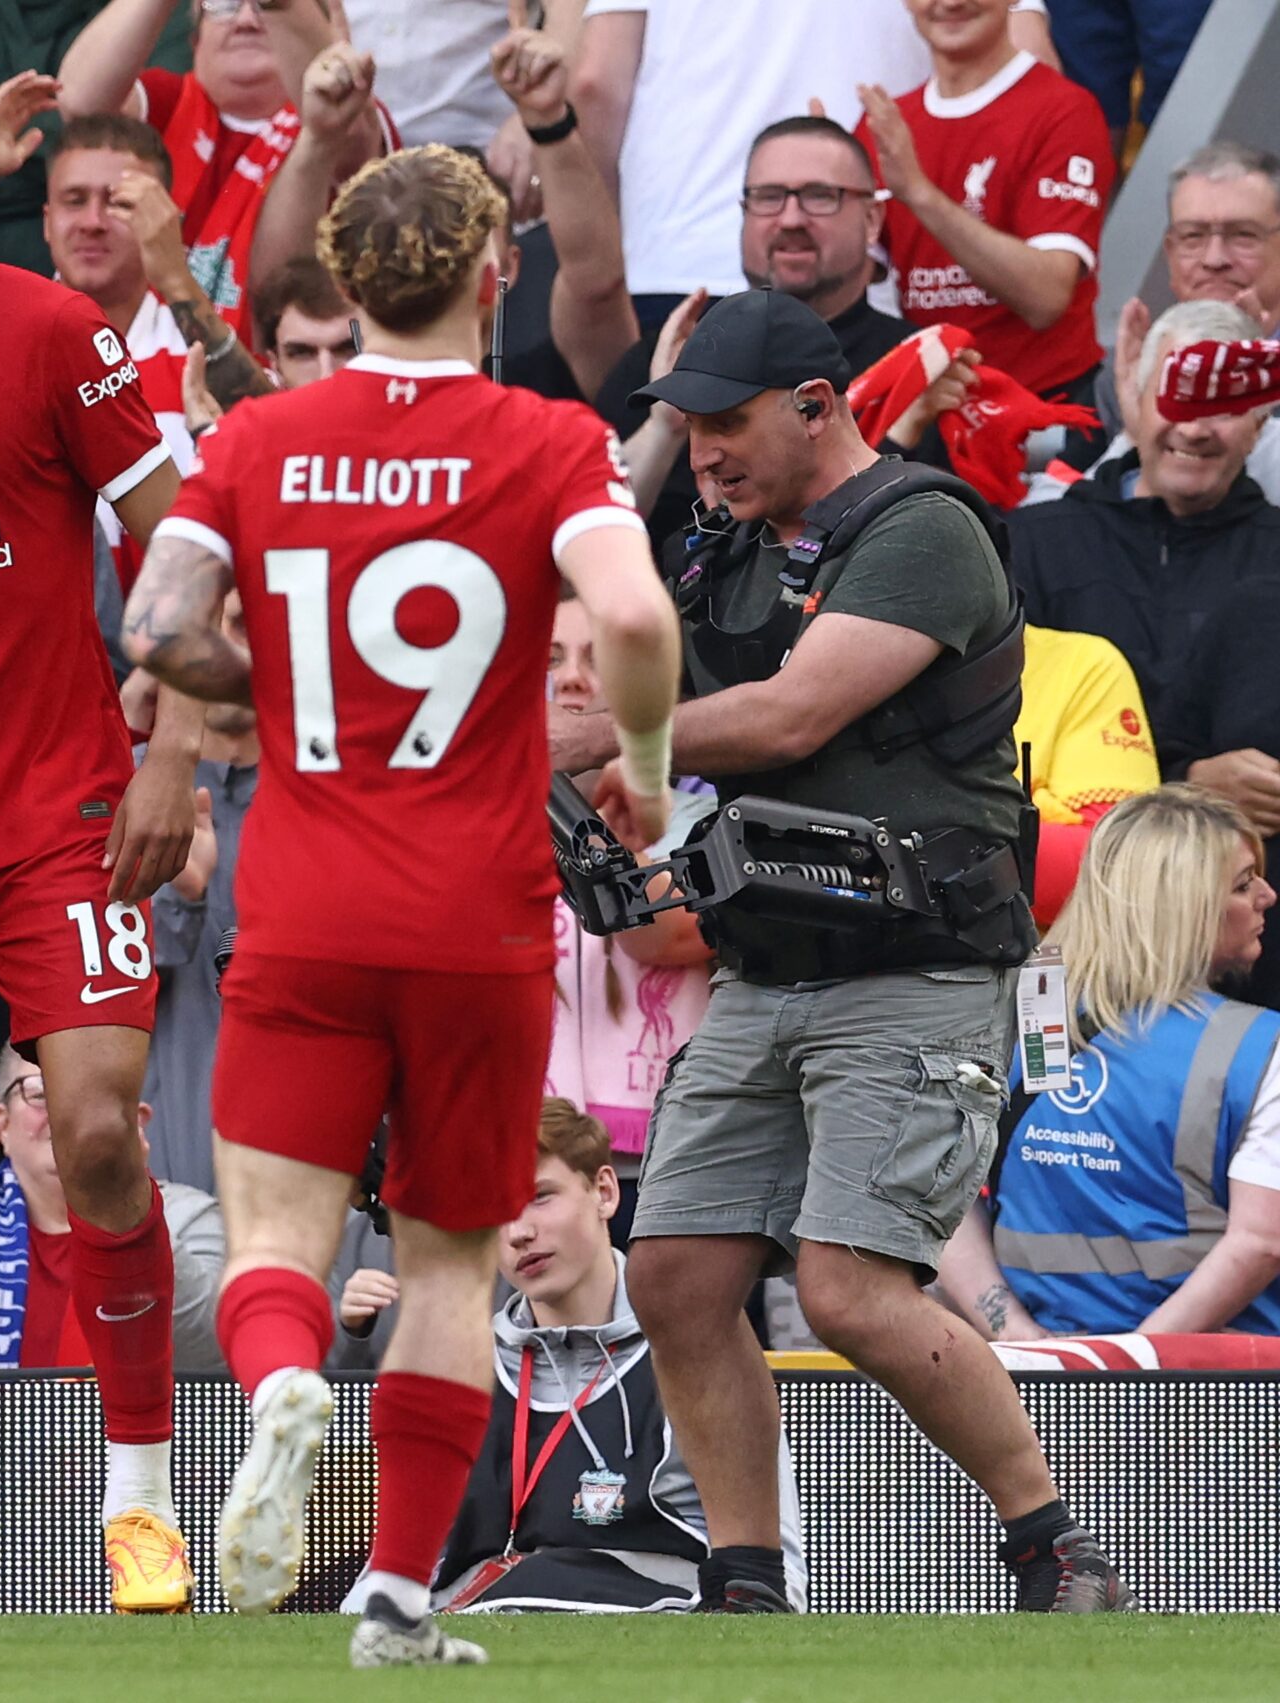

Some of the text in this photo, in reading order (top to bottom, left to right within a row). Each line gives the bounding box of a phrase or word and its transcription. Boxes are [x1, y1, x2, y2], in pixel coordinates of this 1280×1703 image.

[280, 455, 472, 507] ELLIOTT
[264, 539, 507, 773] 19
[66, 901, 151, 980] 18
[1021, 1145, 1121, 1172] Support Team
[1024, 1124, 1115, 1153] Accessibility
